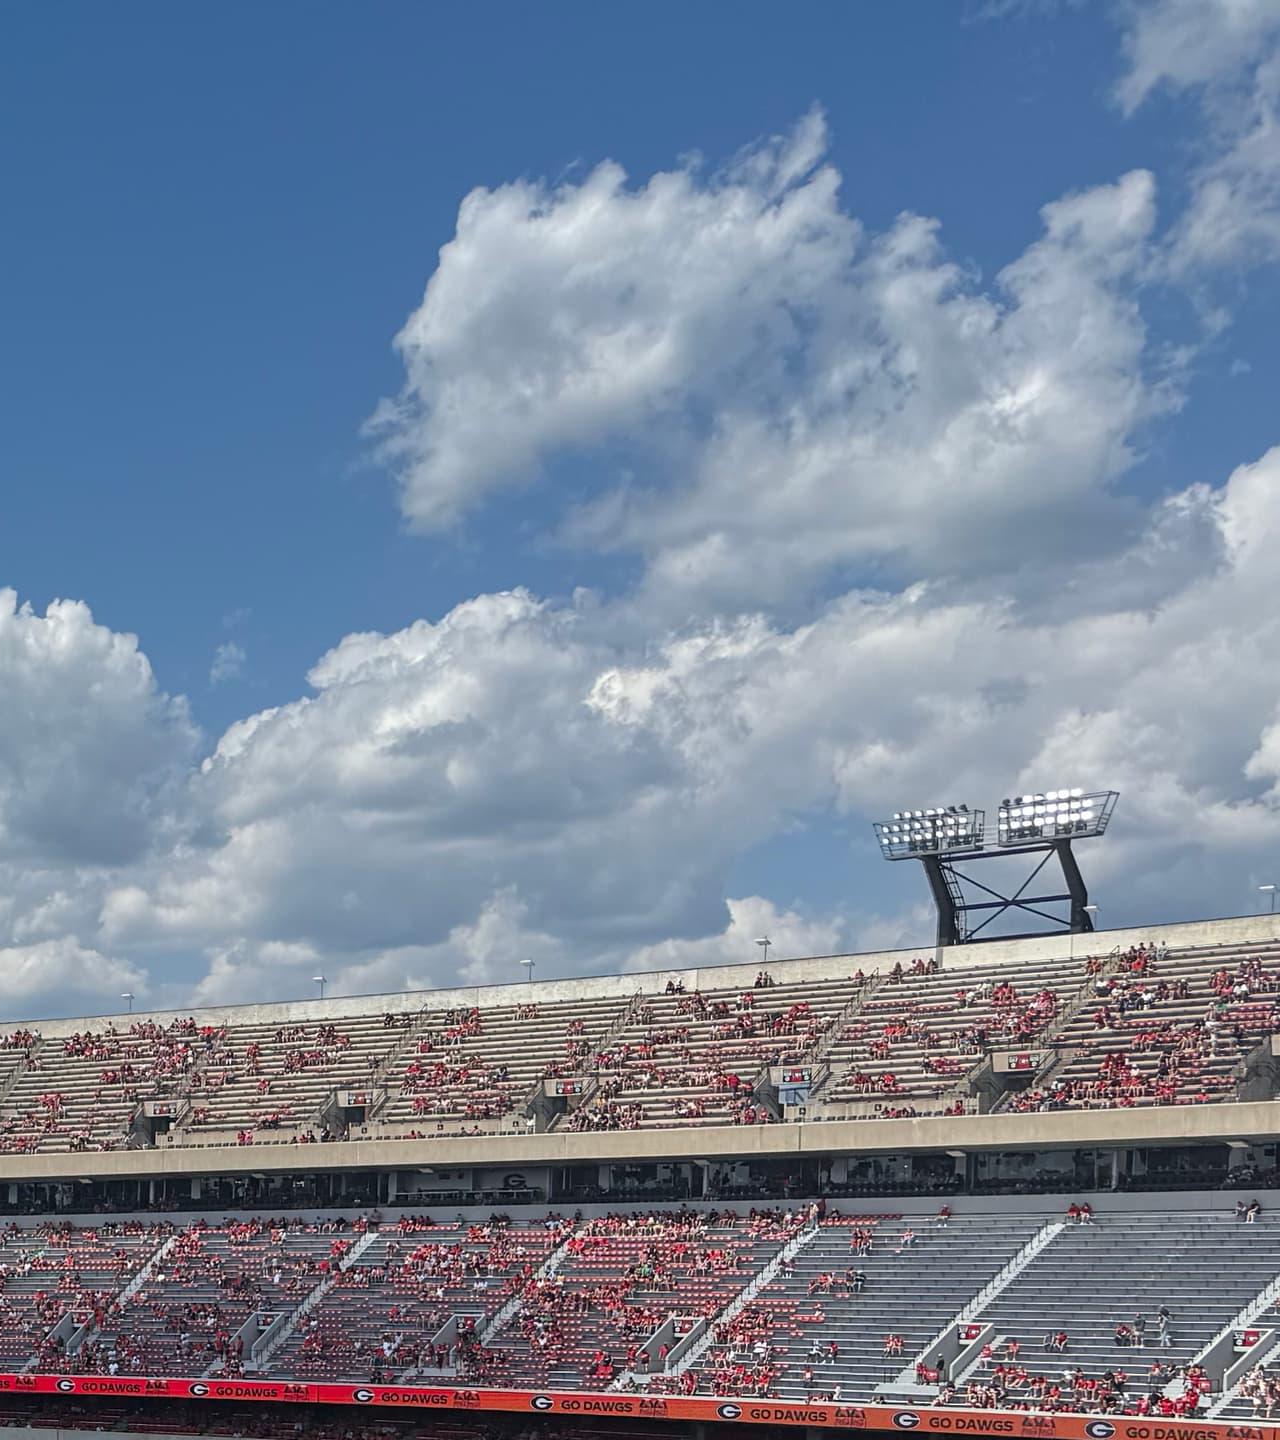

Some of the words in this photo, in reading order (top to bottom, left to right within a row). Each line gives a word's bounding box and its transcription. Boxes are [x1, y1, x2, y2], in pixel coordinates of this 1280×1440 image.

[82, 1382, 98, 1392] GO
[100, 1382, 140, 1393] DAWGS
[216, 1387, 234, 1396] GO
[235, 1388, 278, 1398] DAWGS
[381, 1392, 398, 1402] GO
[402, 1394, 448, 1405] DAWGS
[561, 1400, 581, 1410] GO
[584, 1401, 633, 1412] DAWGS
[750, 1408, 771, 1420] GO
[774, 1410, 828, 1422] DAWGS
[929, 1417, 952, 1430] GO
[955, 1418, 1014, 1432] DAWGS
[1126, 1426, 1150, 1439] GO
